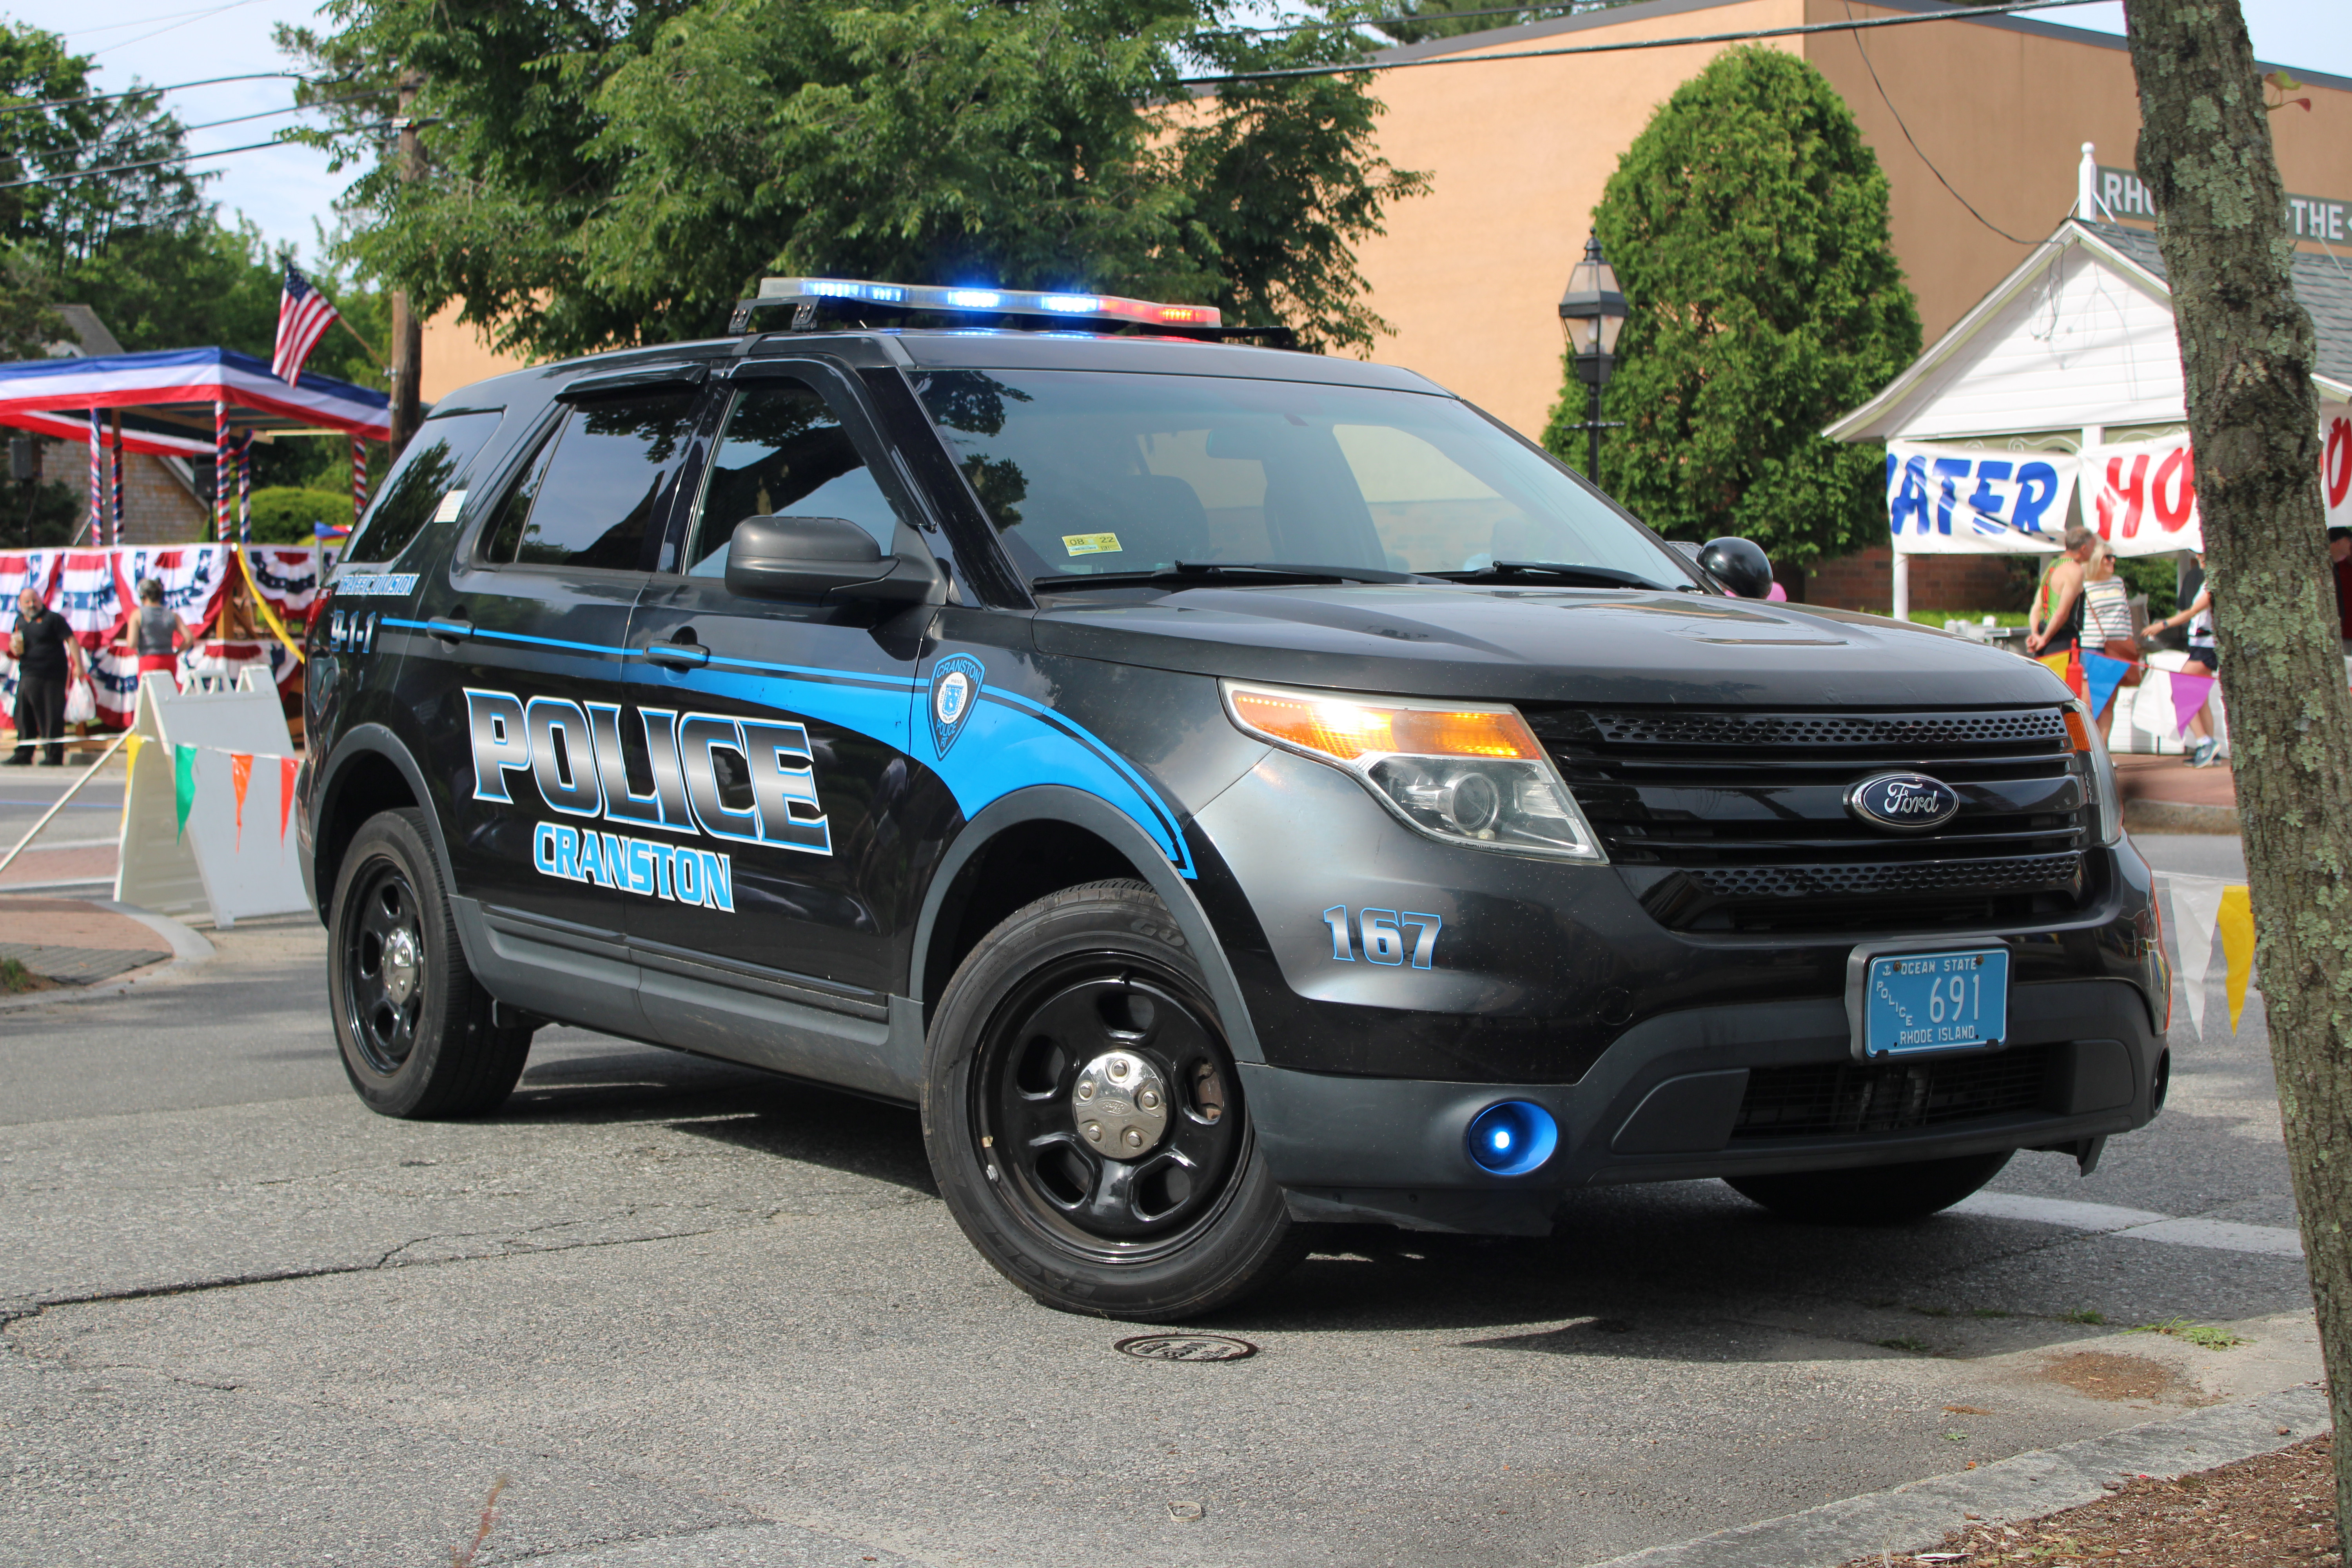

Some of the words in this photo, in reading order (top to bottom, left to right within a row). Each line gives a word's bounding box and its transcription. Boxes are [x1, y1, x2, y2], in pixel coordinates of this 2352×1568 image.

[2290, 199, 2344, 240] THE
[936, 659, 980, 684] CRANSTON
[936, 719, 958, 737] POLICE
[462, 687, 833, 856] POLICE
[1884, 782, 1939, 814] Ford
[533, 821, 735, 913] CRANSTON
[1323, 904, 1442, 970] 167
[1900, 961, 1936, 975] OCEAN
[1944, 958, 1977, 972] STATE
[1876, 981, 1913, 1027] POLICE
[1929, 975, 1980, 1024] 691
[1900, 1029, 1933, 1045] RHODE
[1938, 1025, 1975, 1041] ISLAND
